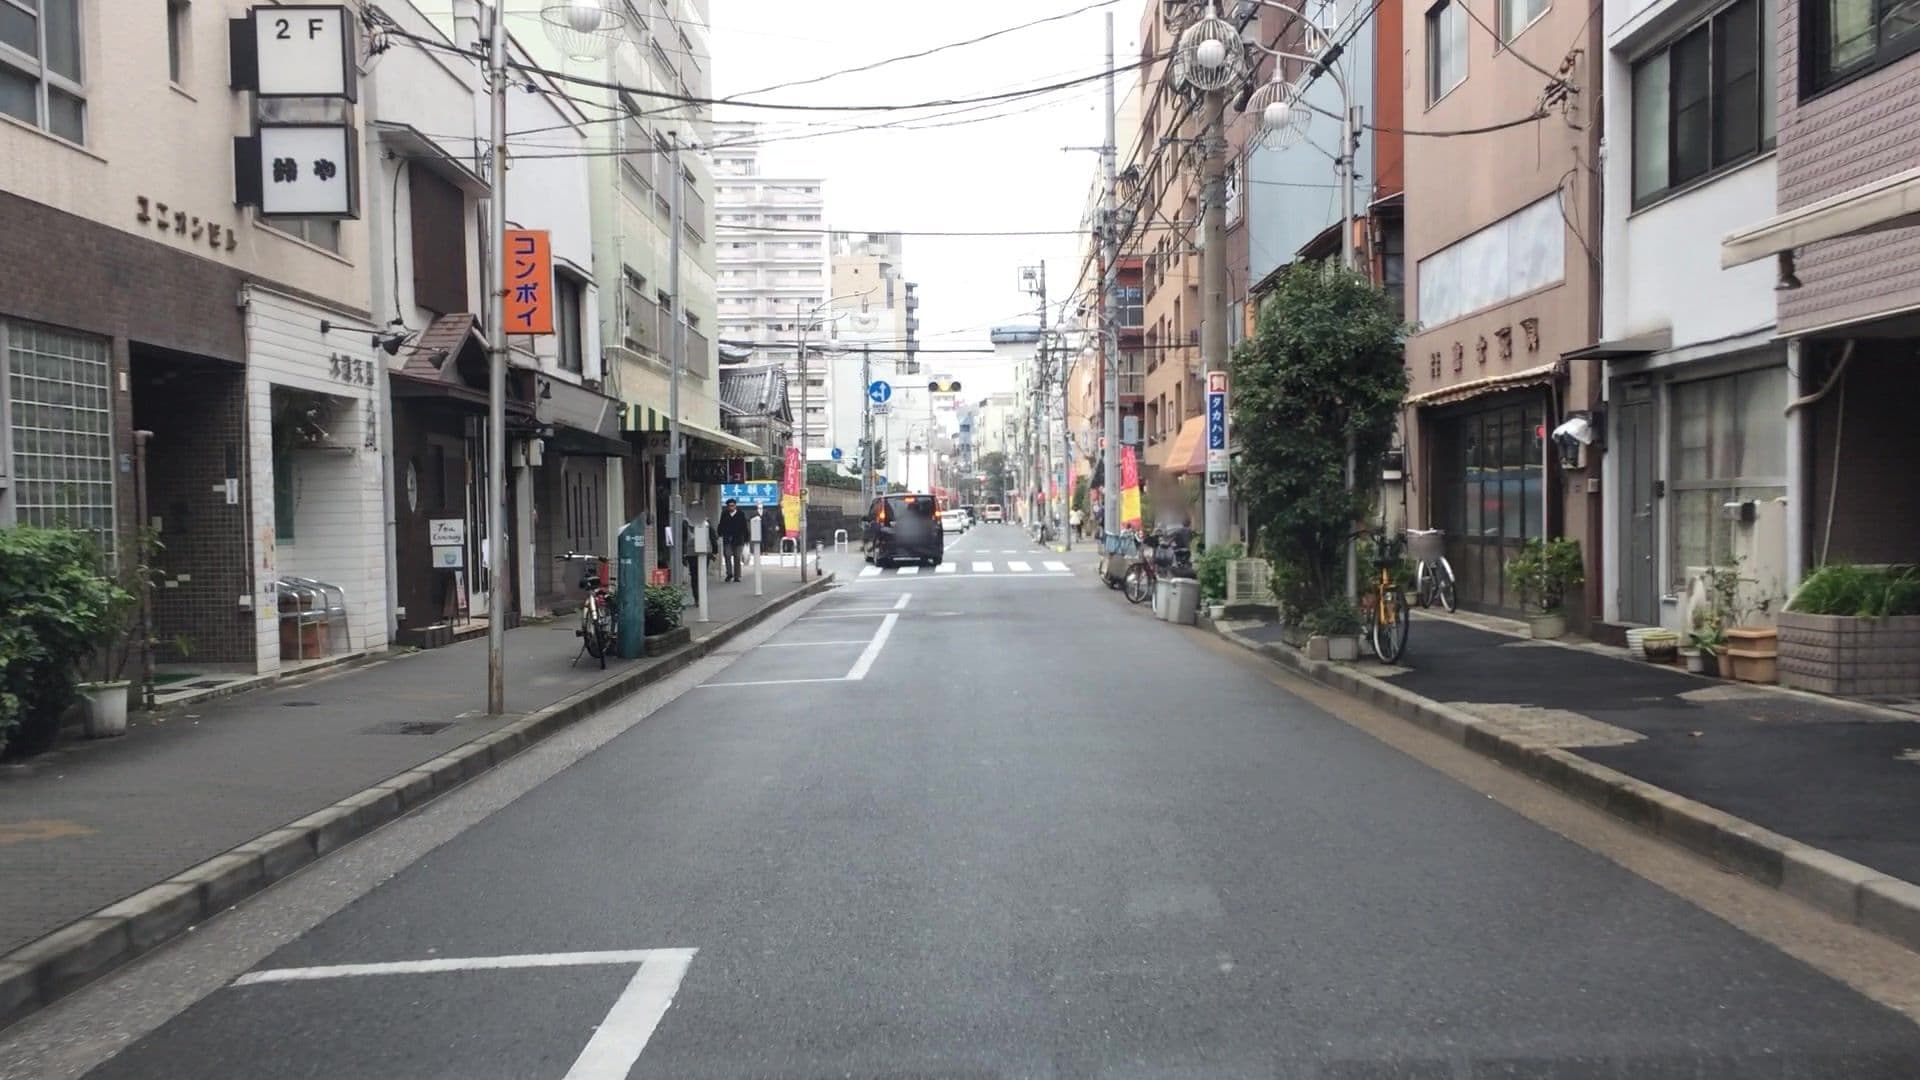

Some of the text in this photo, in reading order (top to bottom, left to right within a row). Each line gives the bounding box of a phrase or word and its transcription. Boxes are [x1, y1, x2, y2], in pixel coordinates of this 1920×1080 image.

[514, 236, 538, 328] コンボイ
[1211, 395, 1223, 448] タカハシ
